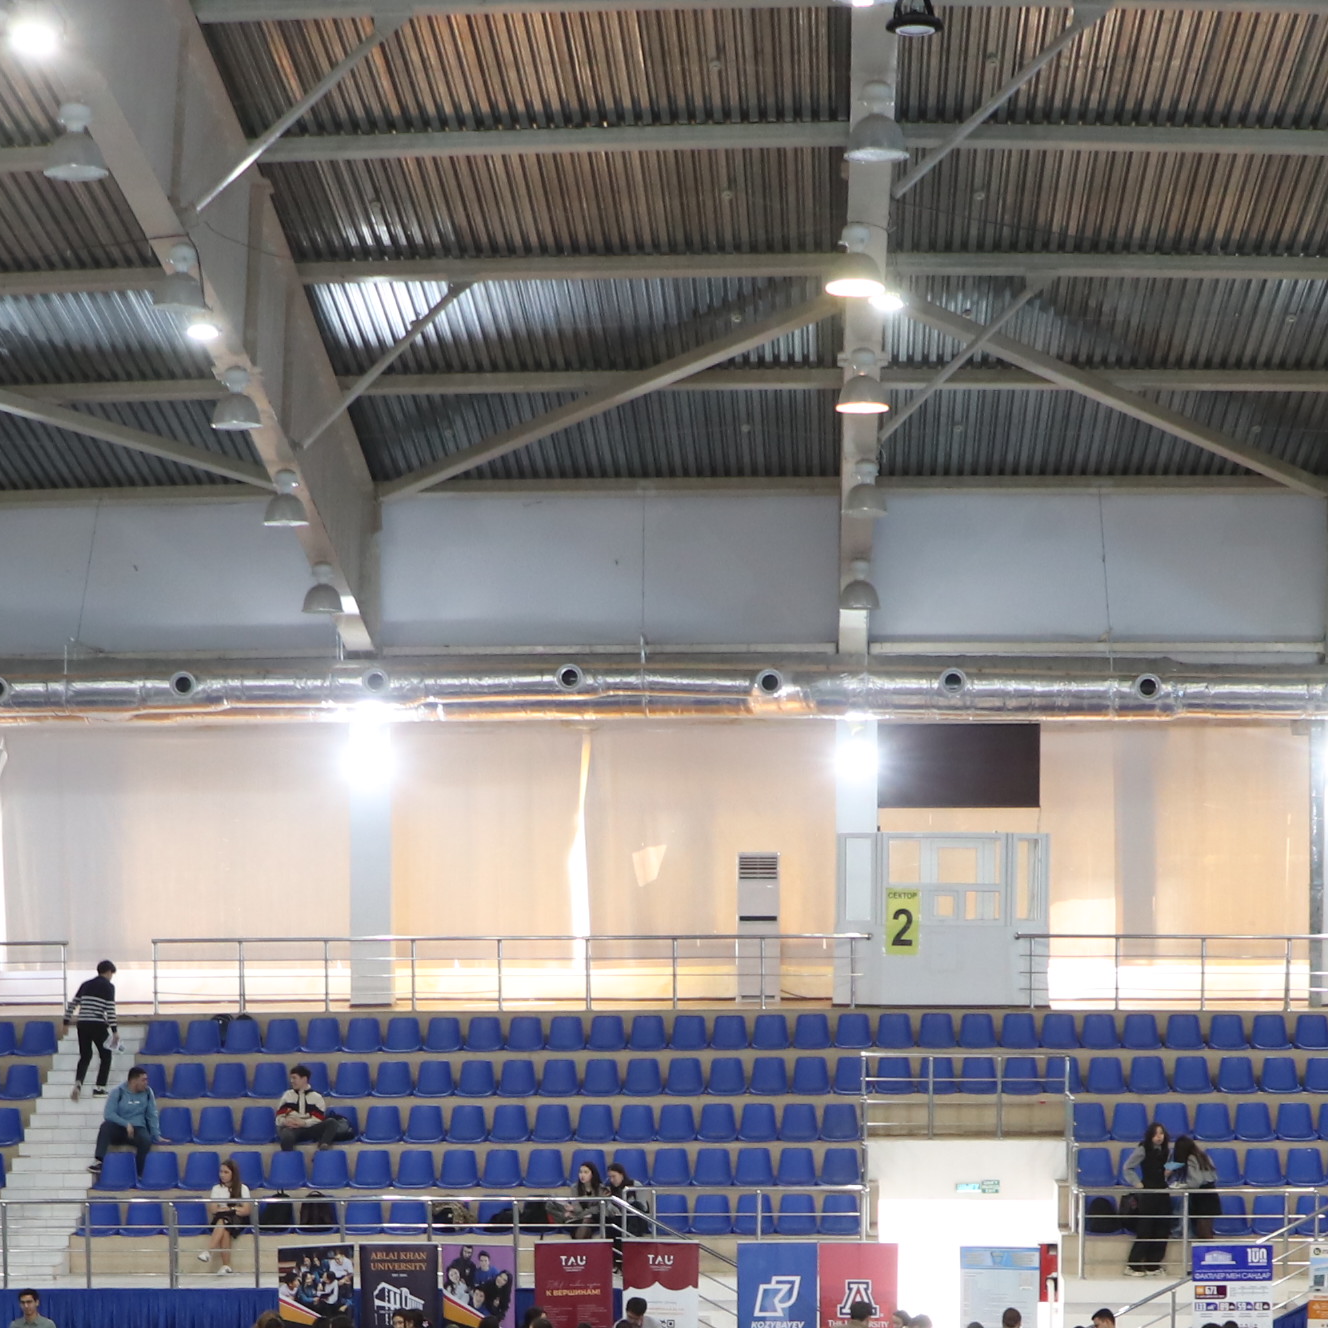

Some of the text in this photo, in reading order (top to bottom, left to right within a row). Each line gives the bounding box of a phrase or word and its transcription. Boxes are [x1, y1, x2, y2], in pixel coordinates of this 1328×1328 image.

[887, 892, 918, 900] СЕКТОР
[891, 908, 913, 947] 2
[400, 1251, 427, 1260] KHAN
[647, 1254, 674, 1265] TAU
[560, 1255, 587, 1266] TAU
[370, 1262, 427, 1271] UNIVERSITY
[1241, 1272, 1271, 1280] САНДАР
[751, 1321, 805, 1328] KOZYBAYEV
